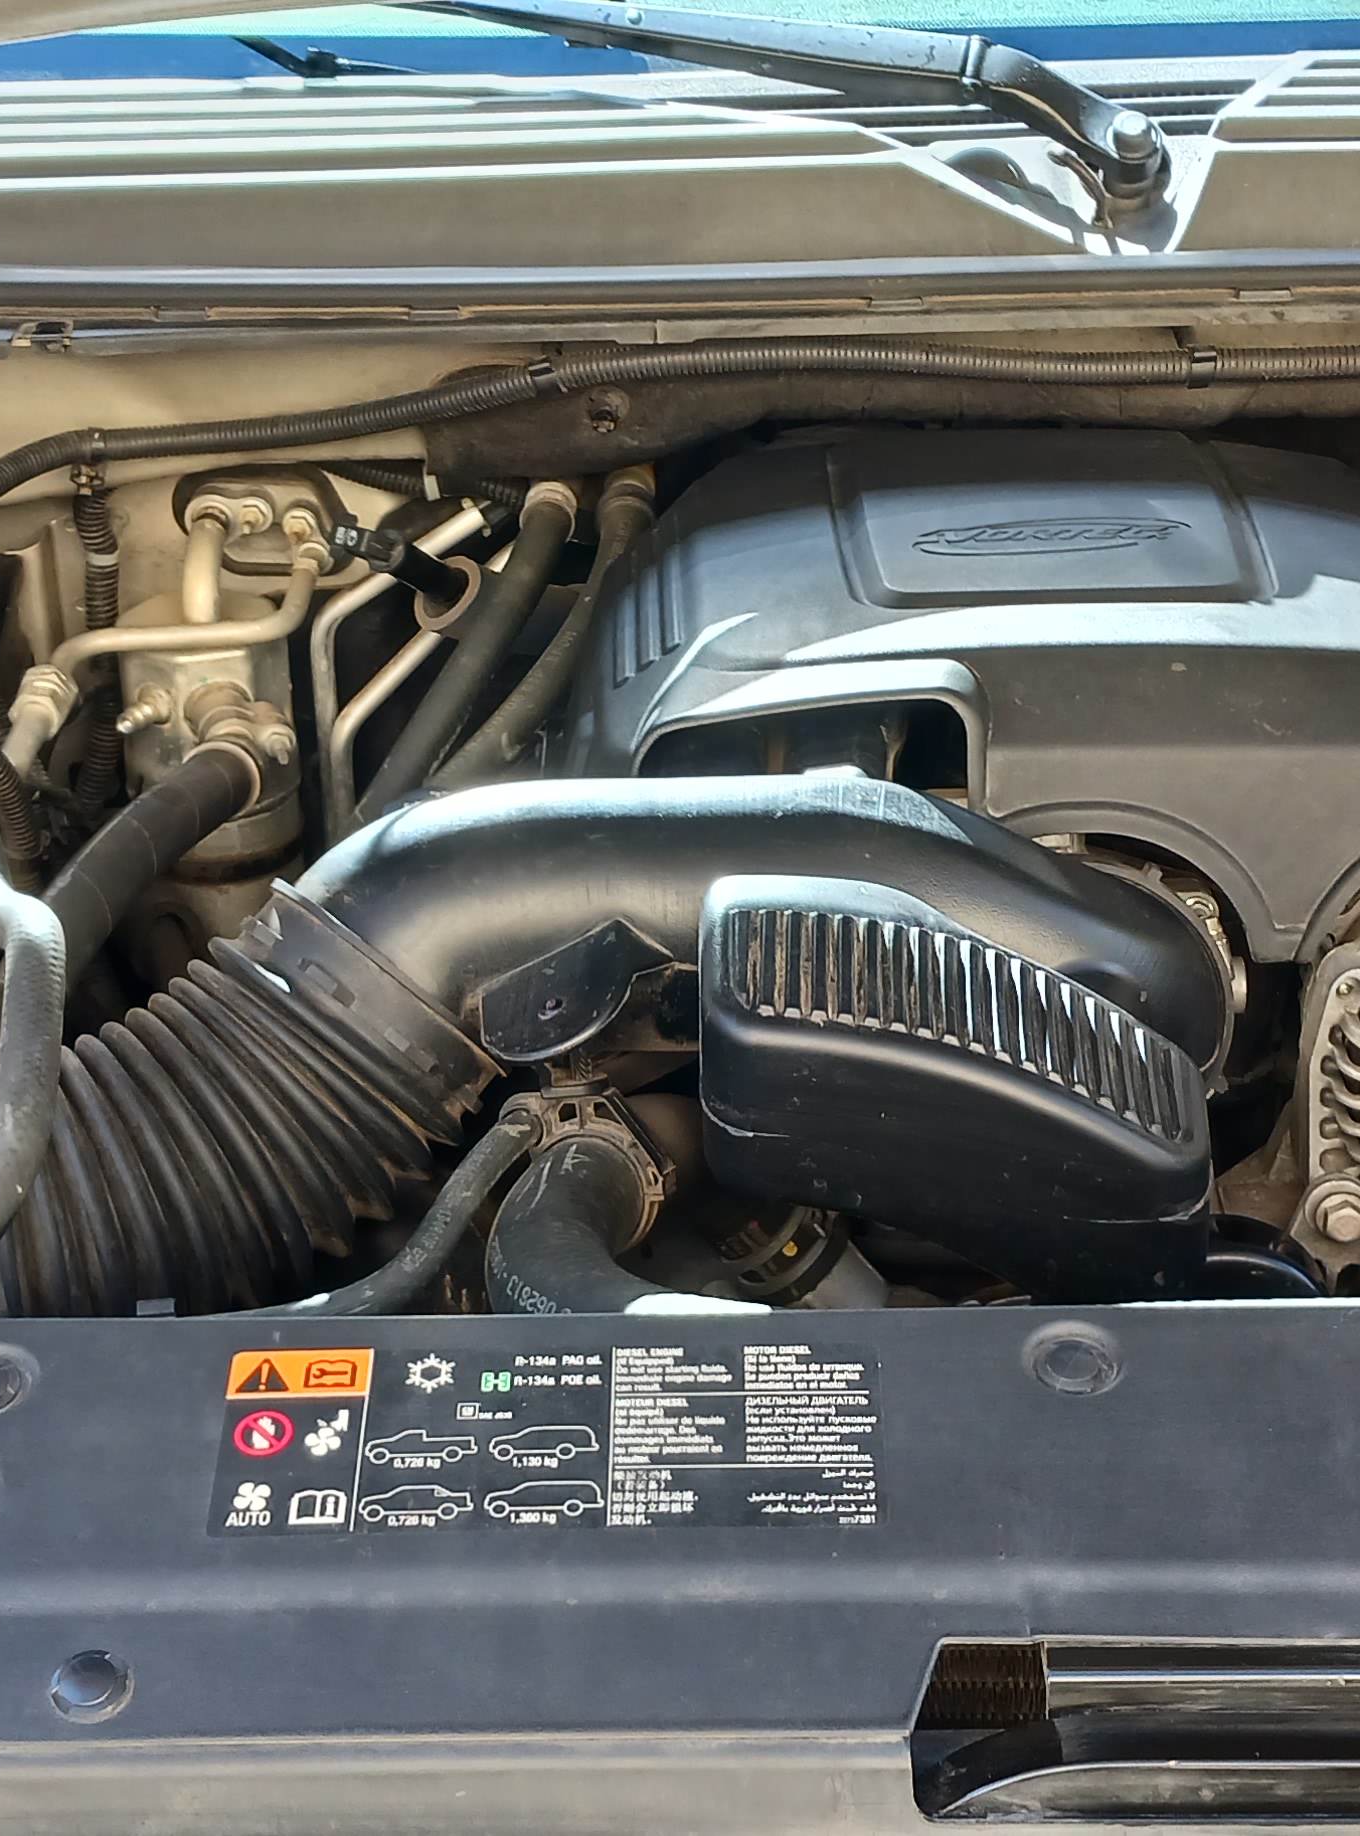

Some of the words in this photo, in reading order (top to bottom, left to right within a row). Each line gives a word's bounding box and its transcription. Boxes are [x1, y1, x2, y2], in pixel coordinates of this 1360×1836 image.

[617, 1347, 648, 1357] DIESEL
[650, 1347, 684, 1357] ENGINE
[743, 1345, 778, 1354] MOTOR
[779, 1345, 812, 1354] DIESEL
[515, 1355, 557, 1367] R-134a
[514, 1374, 556, 1387] R-134a
[615, 1398, 655, 1407] MOTEUR
[656, 1397, 689, 1407] DIESEL
[744, 1395, 809, 1407] ДИЗЕЛЬНЫЙ
[810, 1396, 868, 1406] ДВИГАТЕЛЬ
[426, 1456, 441, 1469] kg
[543, 1456, 559, 1469] kg
[224, 1510, 272, 1527] AUTO
[421, 1514, 436, 1527] kg
[541, 1511, 557, 1525] kg
